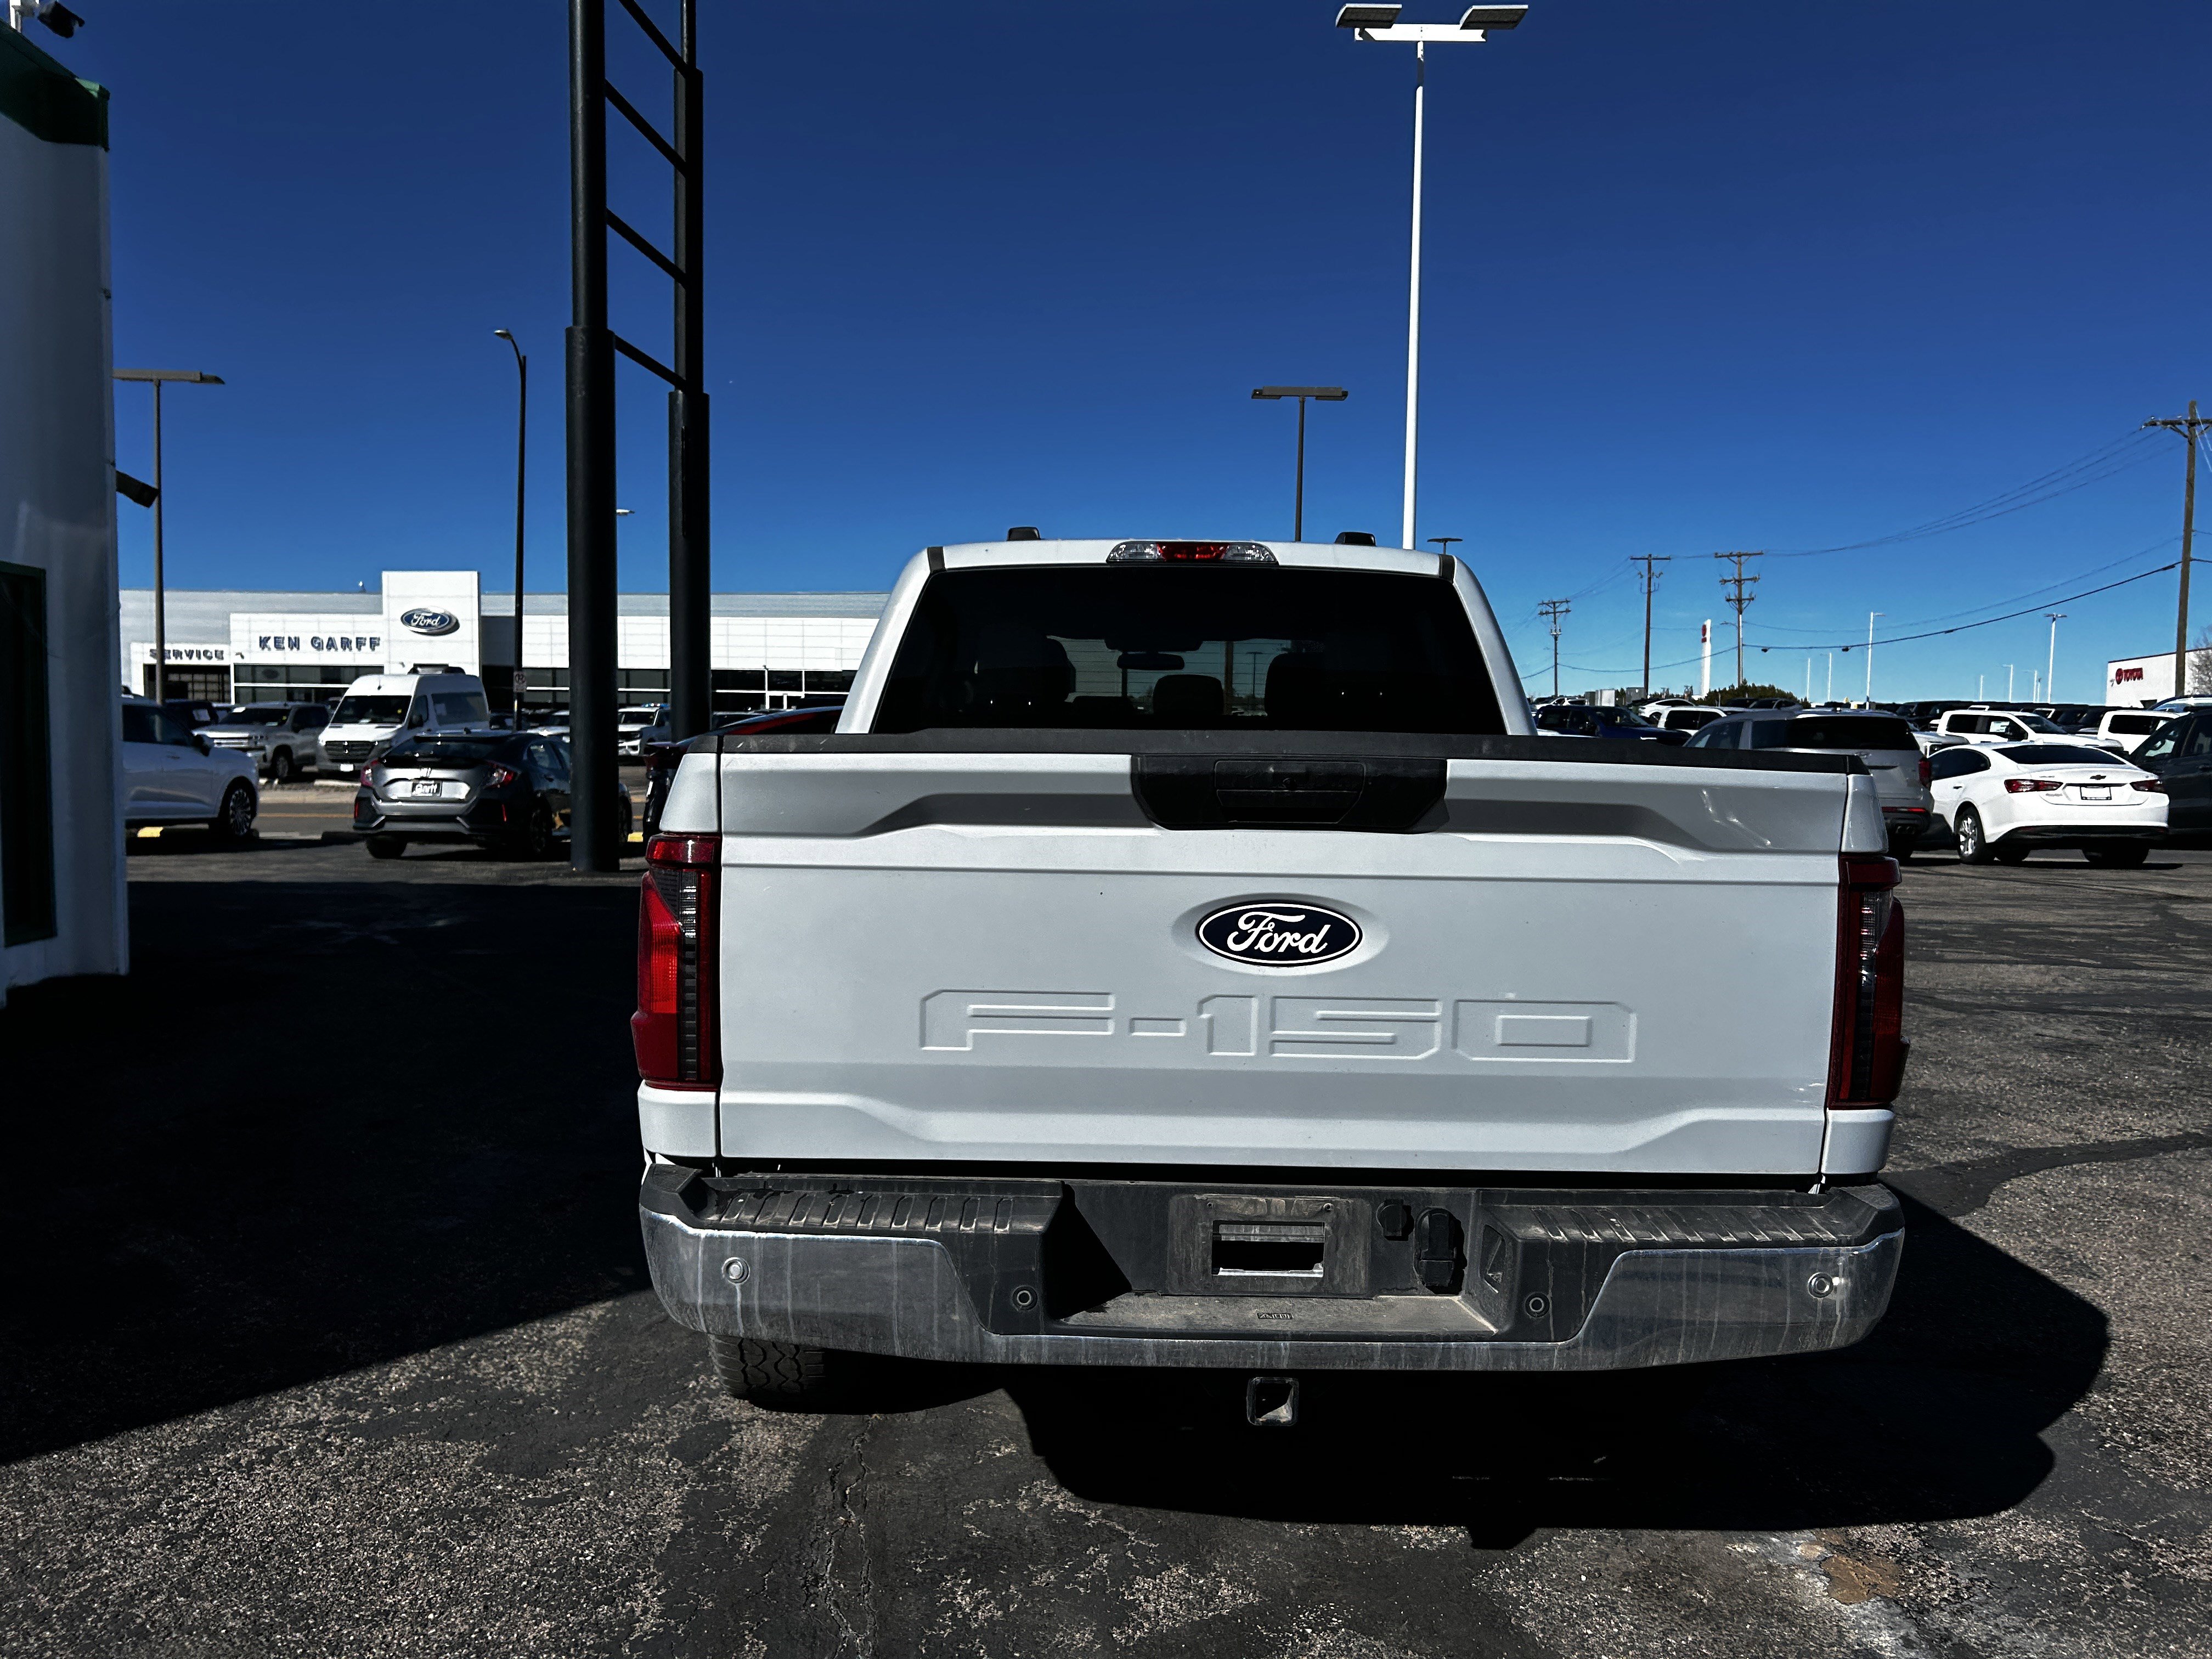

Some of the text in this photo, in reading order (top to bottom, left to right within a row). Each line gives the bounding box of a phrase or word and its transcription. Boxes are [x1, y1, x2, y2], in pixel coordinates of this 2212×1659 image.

[410, 612, 441, 627] Ford
[259, 635, 381, 652] KEN GARFF
[149, 648, 224, 661] SERVICE
[1227, 911, 1331, 954] Ford
[919, 989, 1638, 1063] F-150
